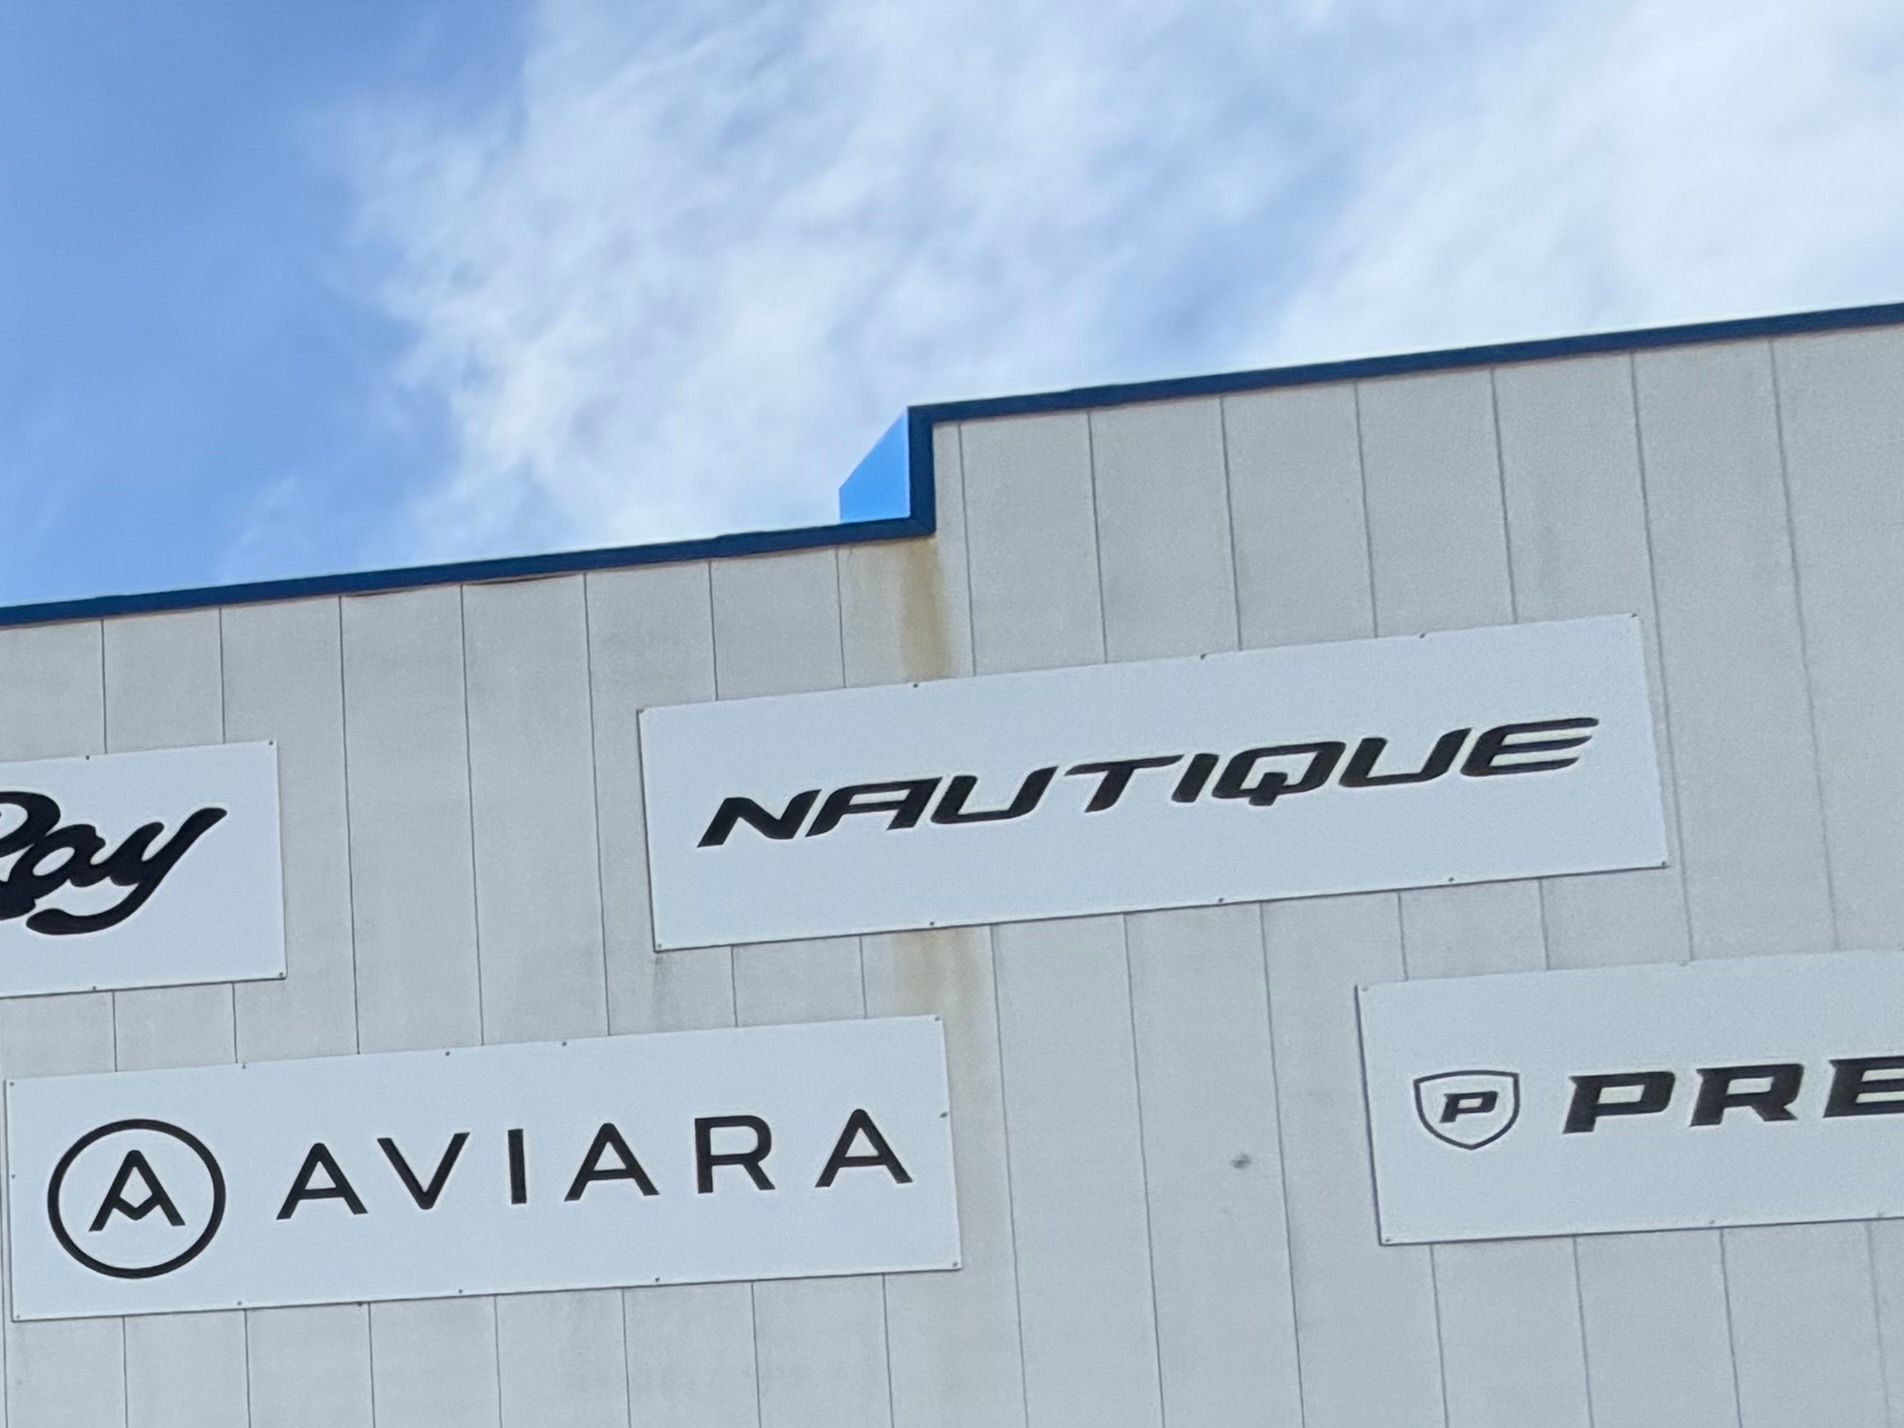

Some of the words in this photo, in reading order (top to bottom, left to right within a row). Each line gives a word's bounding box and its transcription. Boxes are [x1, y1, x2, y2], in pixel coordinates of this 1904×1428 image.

[696, 717, 1599, 848] NAUTIQUE
[1563, 1055, 1904, 1134] PRE
[276, 1108, 913, 1221] AVIARA
